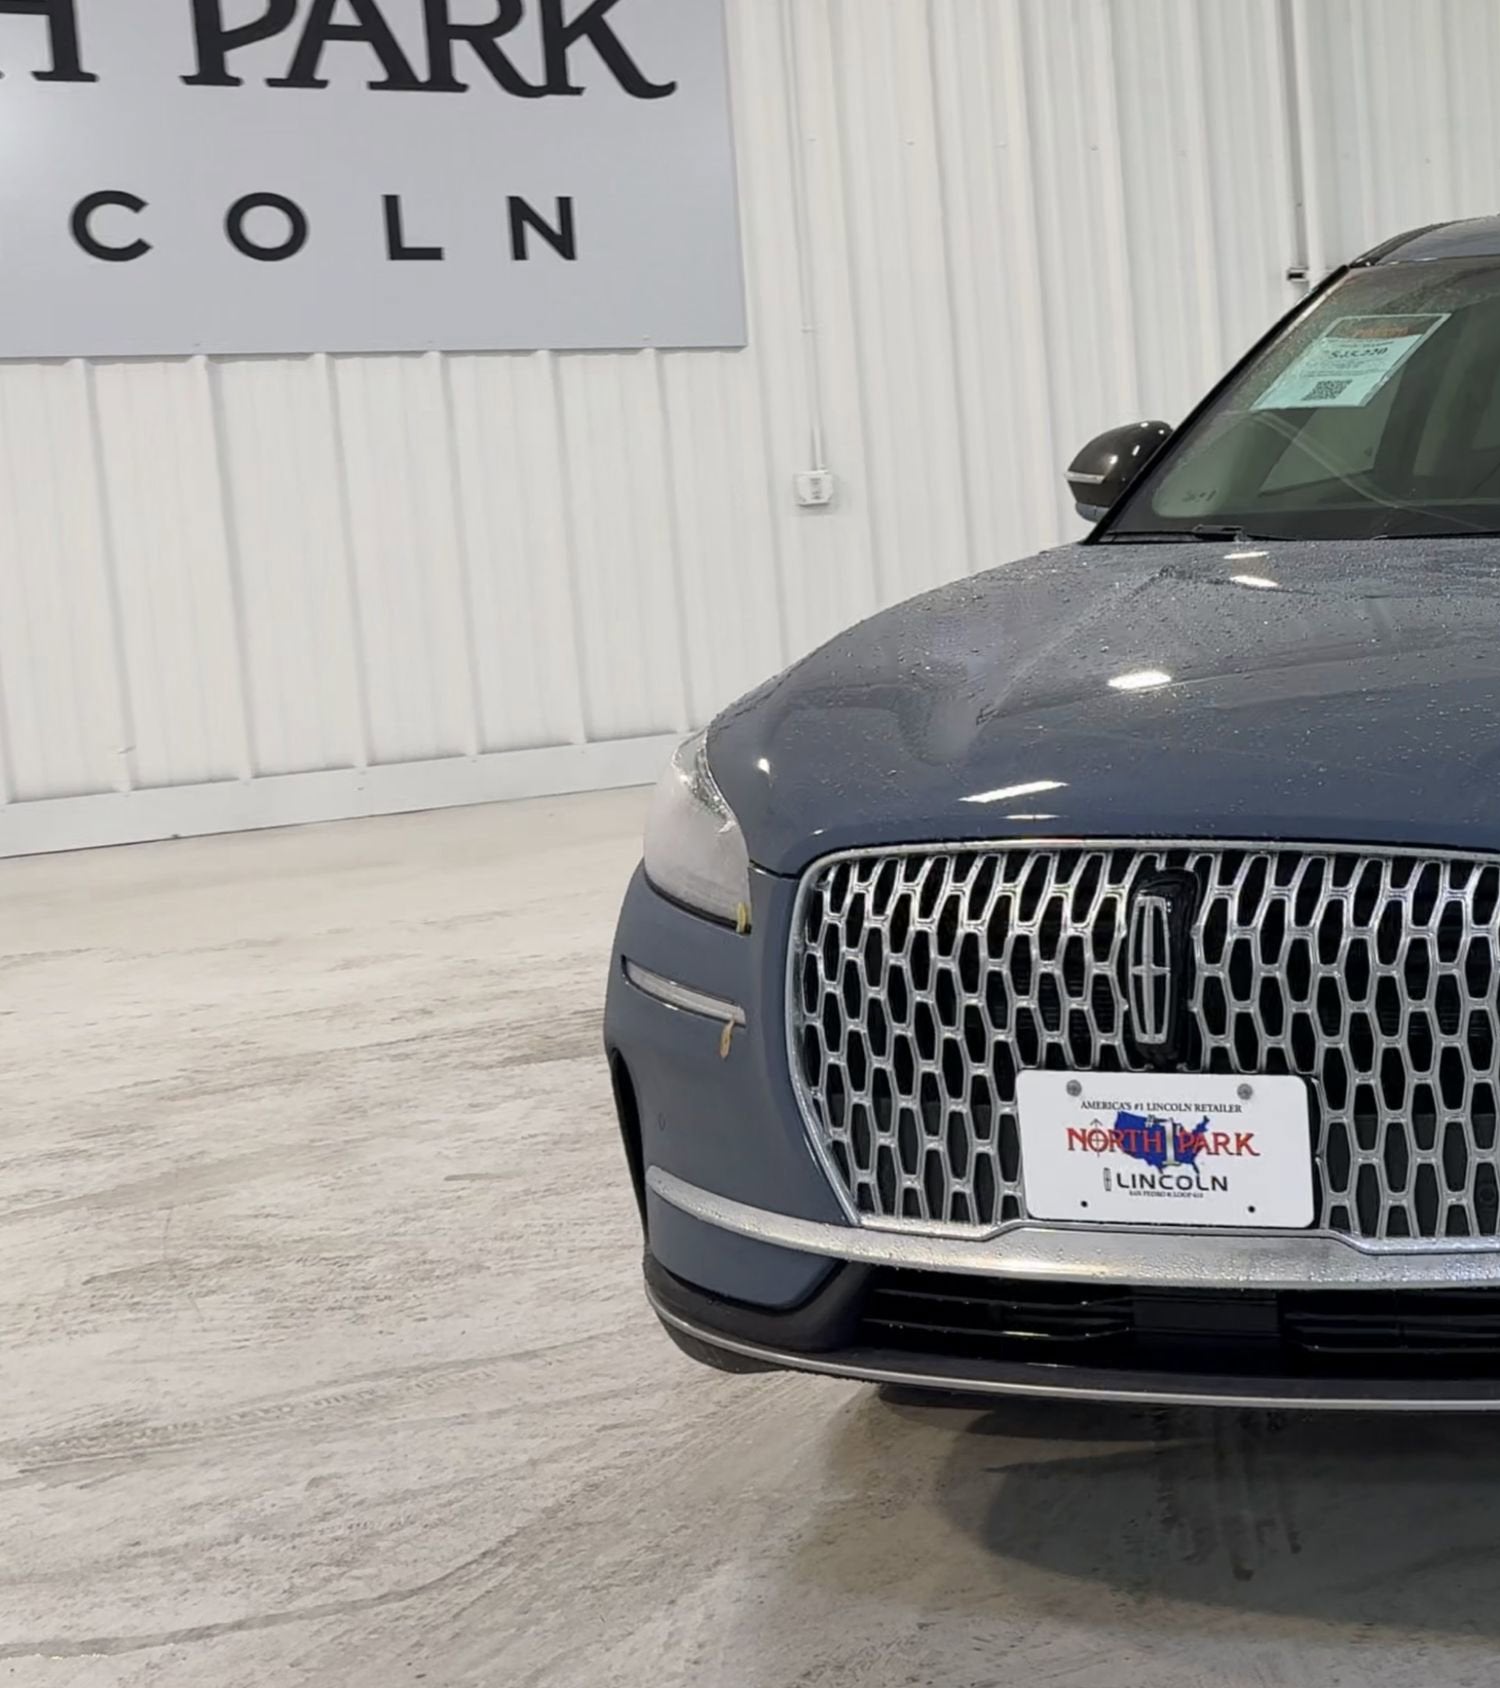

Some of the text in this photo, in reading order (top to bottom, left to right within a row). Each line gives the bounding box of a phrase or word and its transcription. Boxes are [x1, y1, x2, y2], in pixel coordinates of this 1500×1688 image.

[180, 0, 677, 99] PARK
[1080, 1100, 1132, 1111] AMERICA'S
[1146, 1102, 1193, 1112] LINCOLN
[1194, 1103, 1243, 1113] RETAILER
[1065, 1127, 1261, 1157] NORTH PARK
[1115, 1172, 1229, 1192] LINCOLN
